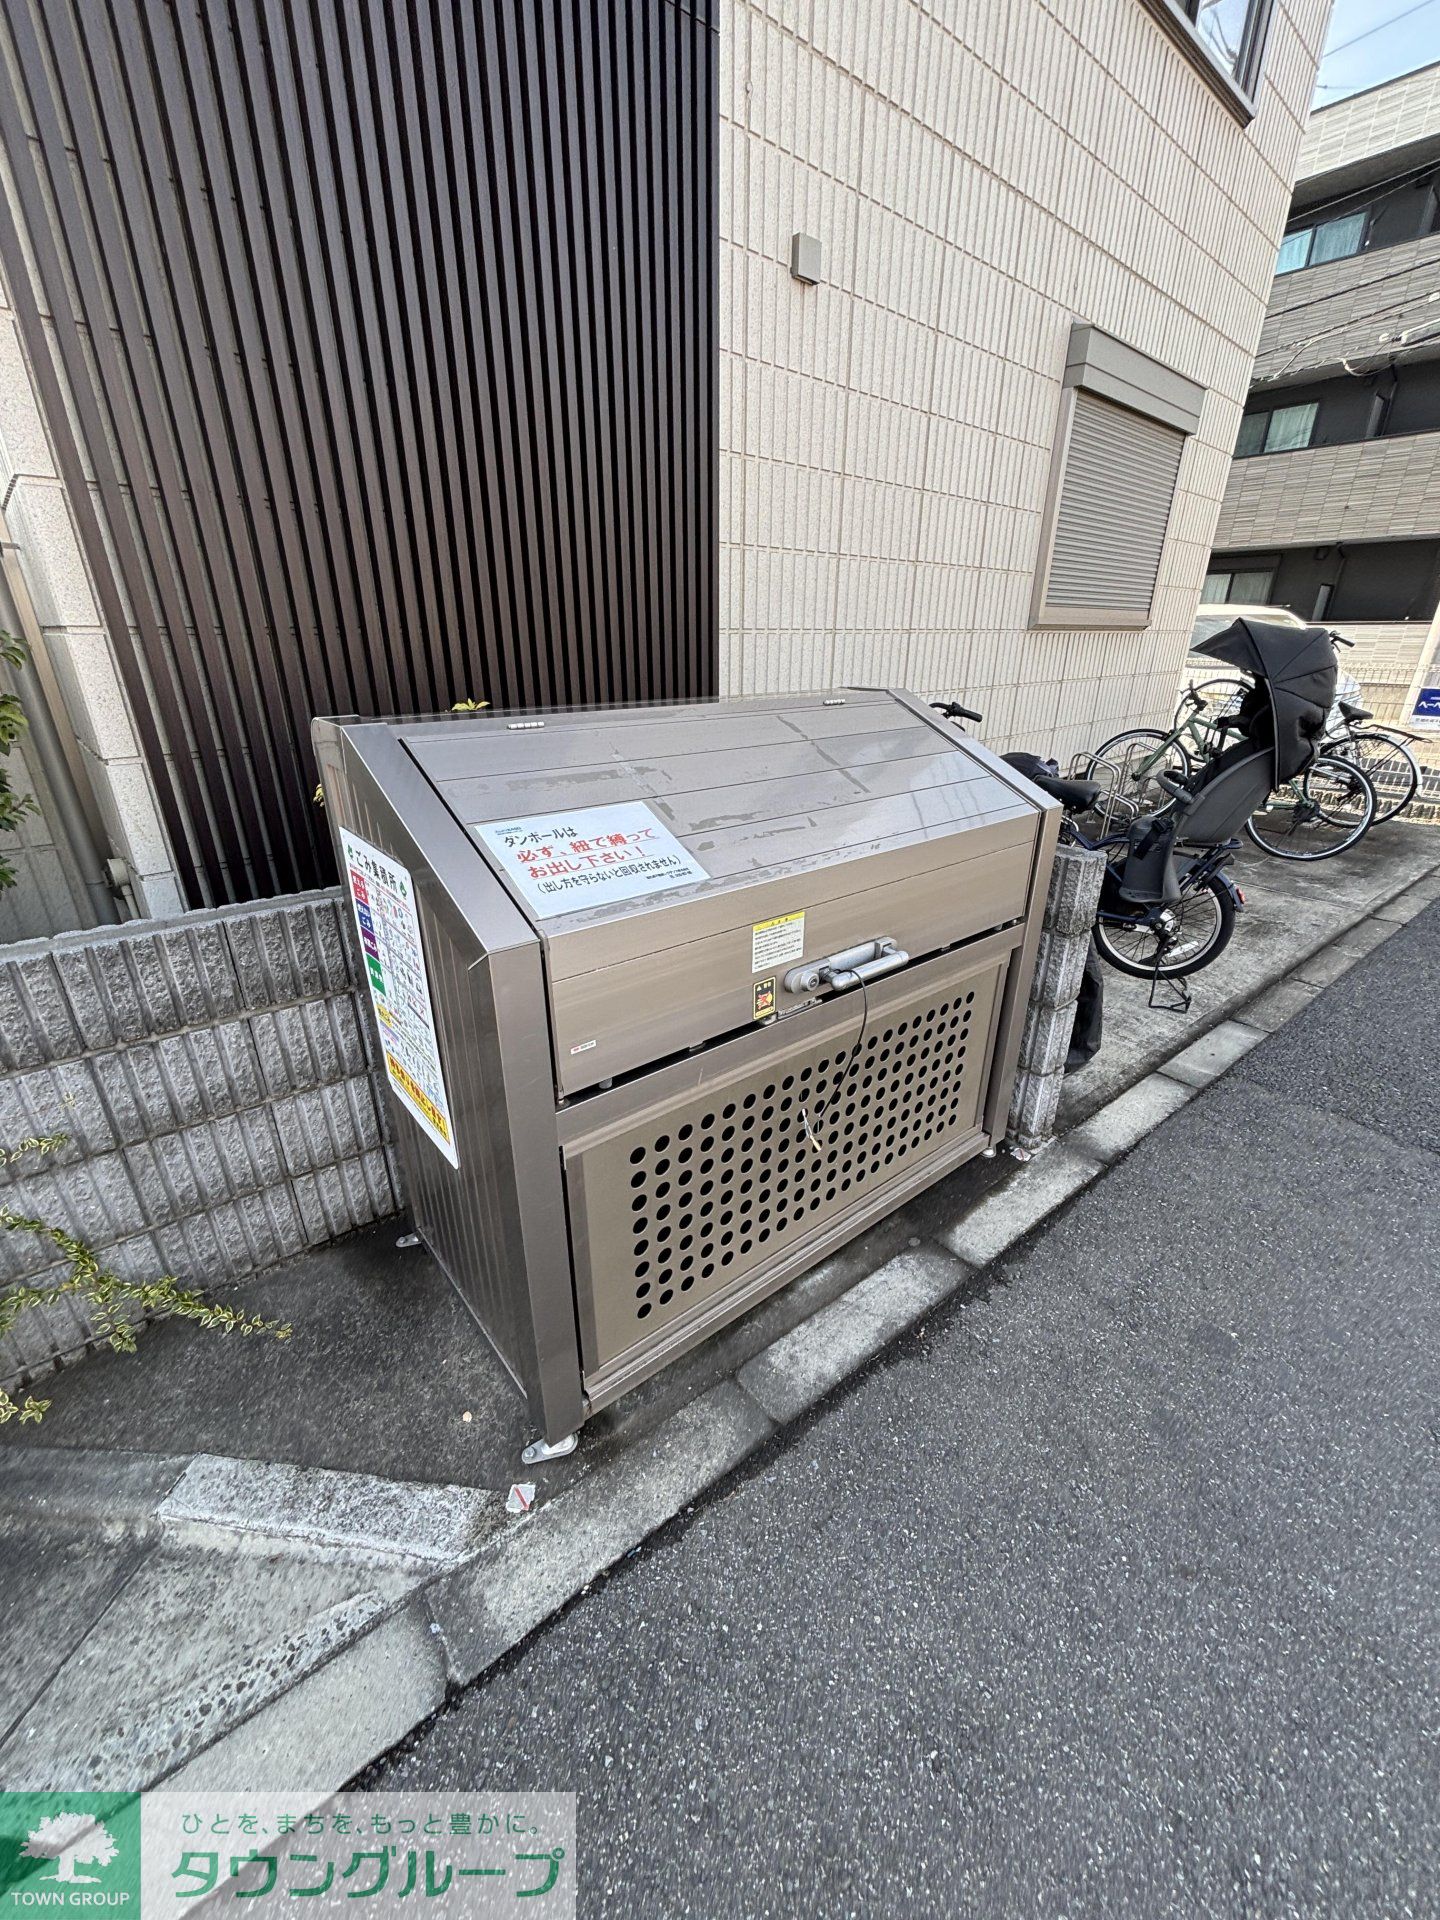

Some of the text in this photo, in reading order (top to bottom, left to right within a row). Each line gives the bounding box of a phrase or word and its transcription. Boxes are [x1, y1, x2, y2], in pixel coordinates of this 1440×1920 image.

[504, 827, 578, 847] ダンボールは
[517, 828, 656, 864] 必ず、紐で縛って
[355, 850, 398, 893] ごみ集積所
[528, 846, 646, 879] お出し下さい！
